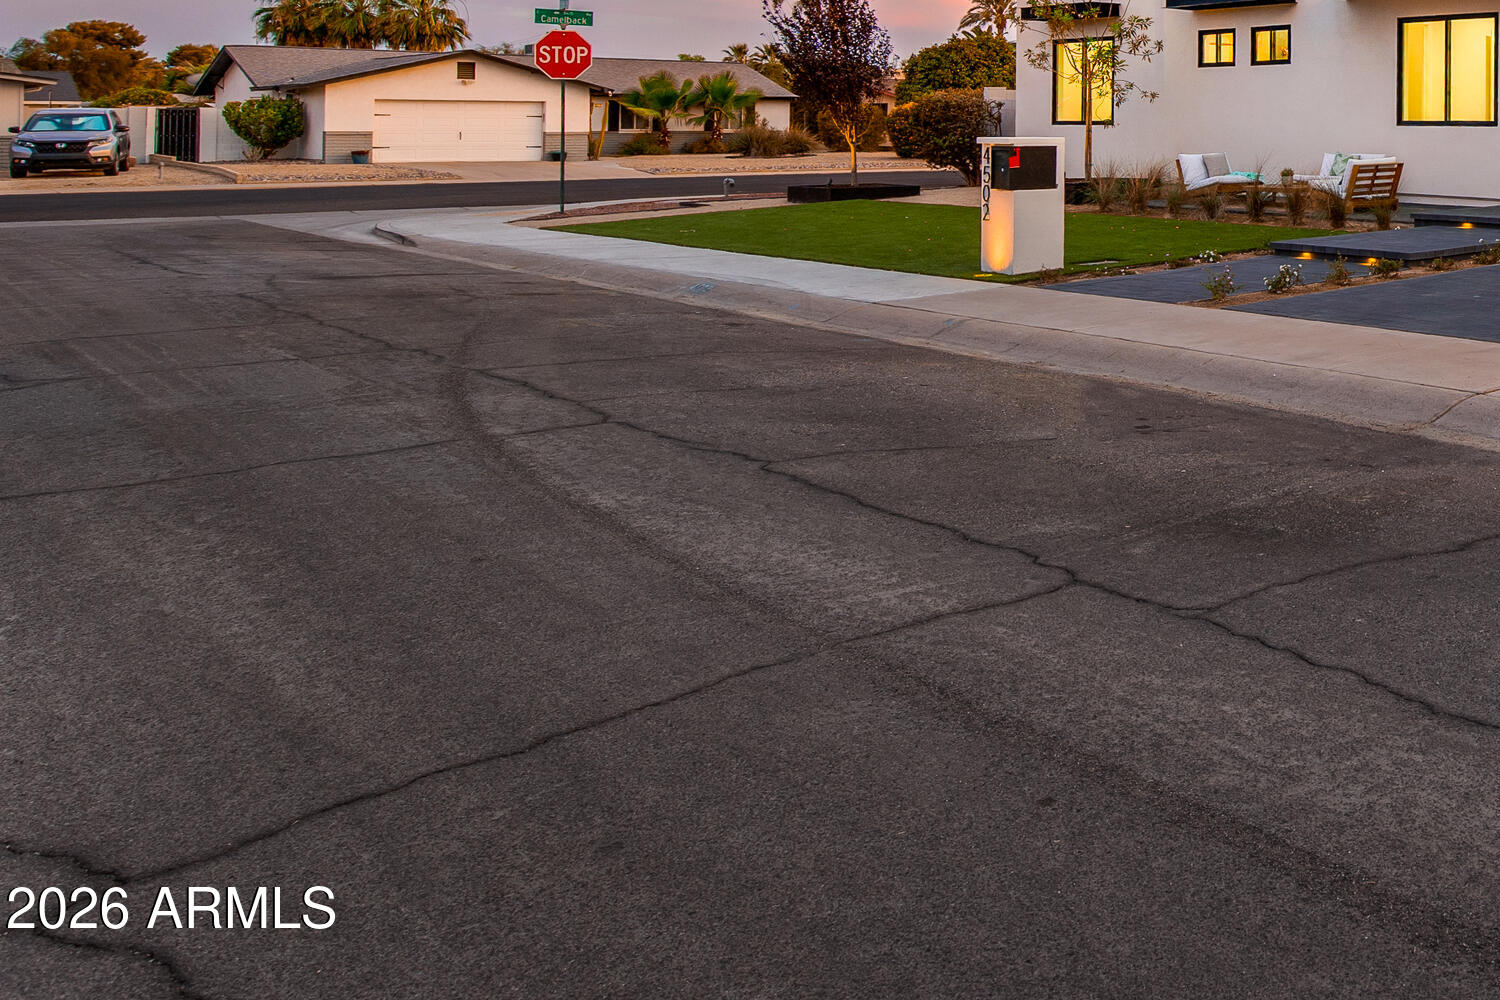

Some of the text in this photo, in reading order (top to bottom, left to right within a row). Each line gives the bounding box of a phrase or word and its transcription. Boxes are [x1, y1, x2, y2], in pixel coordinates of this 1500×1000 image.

[540, 14, 587, 25] Camelback
[539, 45, 588, 64] STOP
[982, 146, 991, 221] 4502
